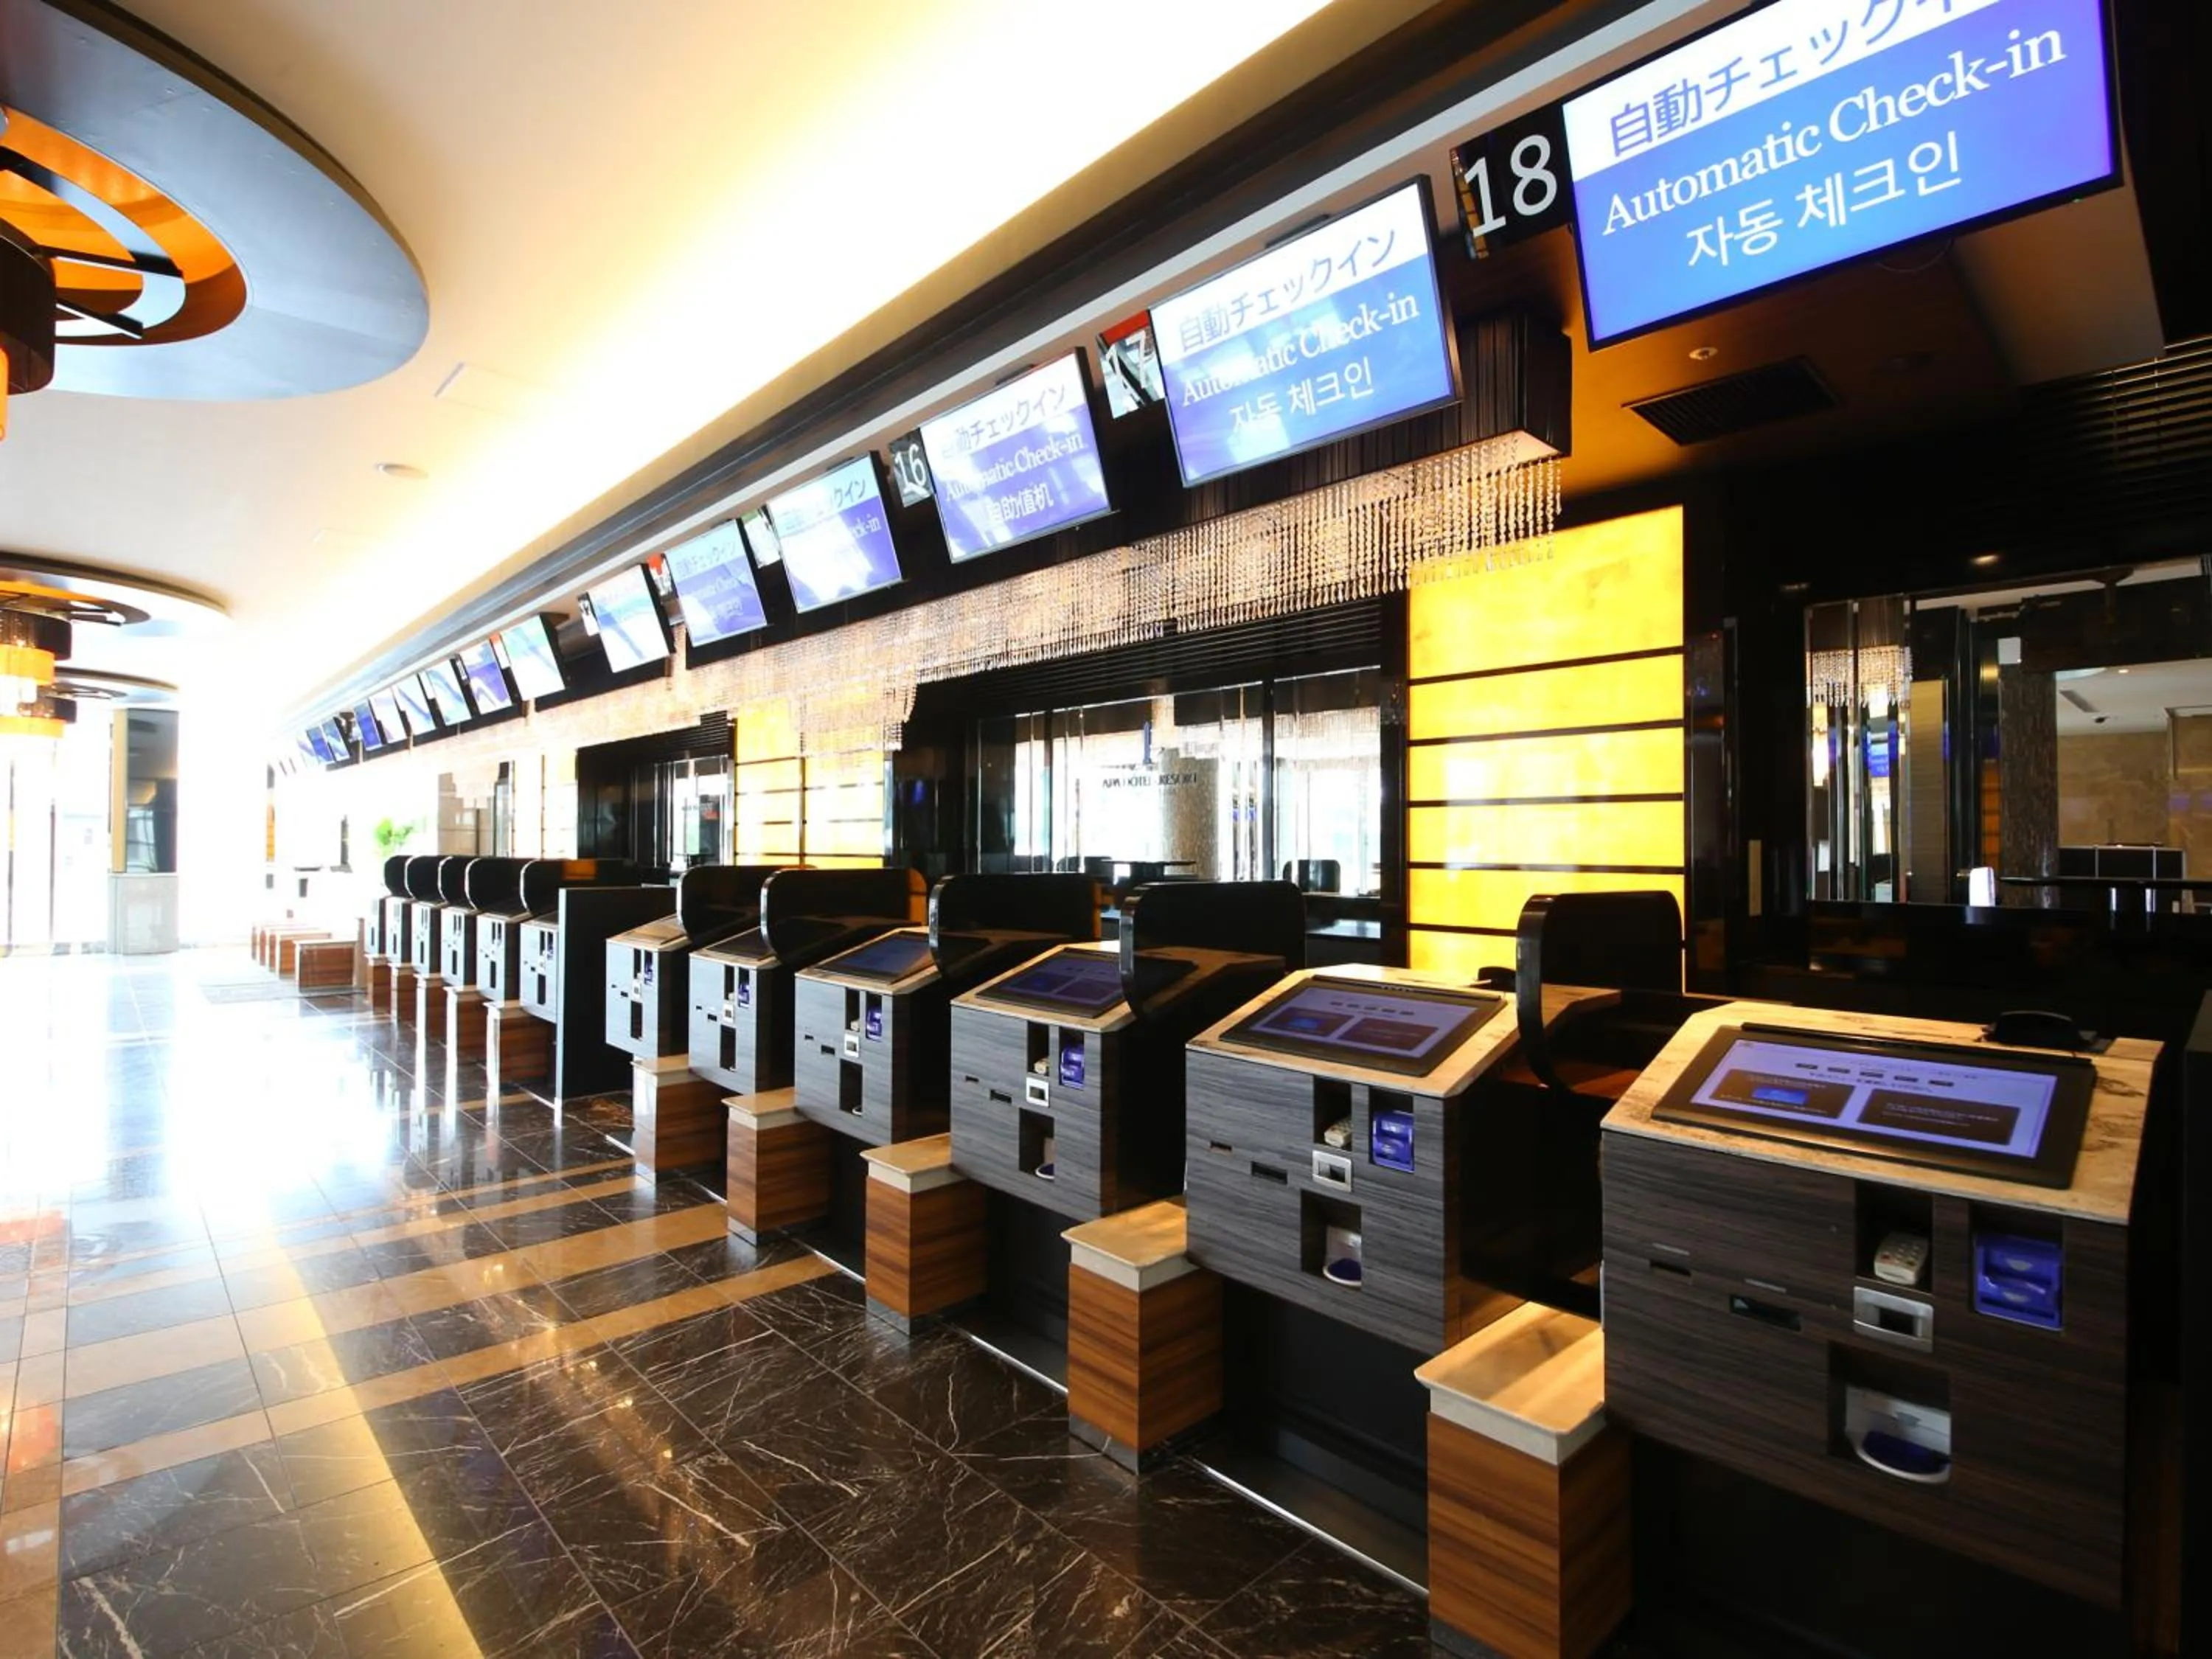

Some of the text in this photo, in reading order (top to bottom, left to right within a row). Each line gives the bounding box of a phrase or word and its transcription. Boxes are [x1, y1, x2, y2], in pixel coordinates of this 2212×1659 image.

[1601, 29, 2067, 235] Automatic Check-in
[1610, 0, 1952, 157] 自動チェック
[1464, 136, 1558, 237] 18
[1686, 131, 1961, 268] 자동 체크인
[1180, 230, 1395, 352] 自動チェックイン
[1182, 291, 1420, 406] Autoatic Check-in
[1105, 330, 1146, 400] 17
[1289, 357, 1374, 417] 체크인
[894, 443, 927, 487] 16
